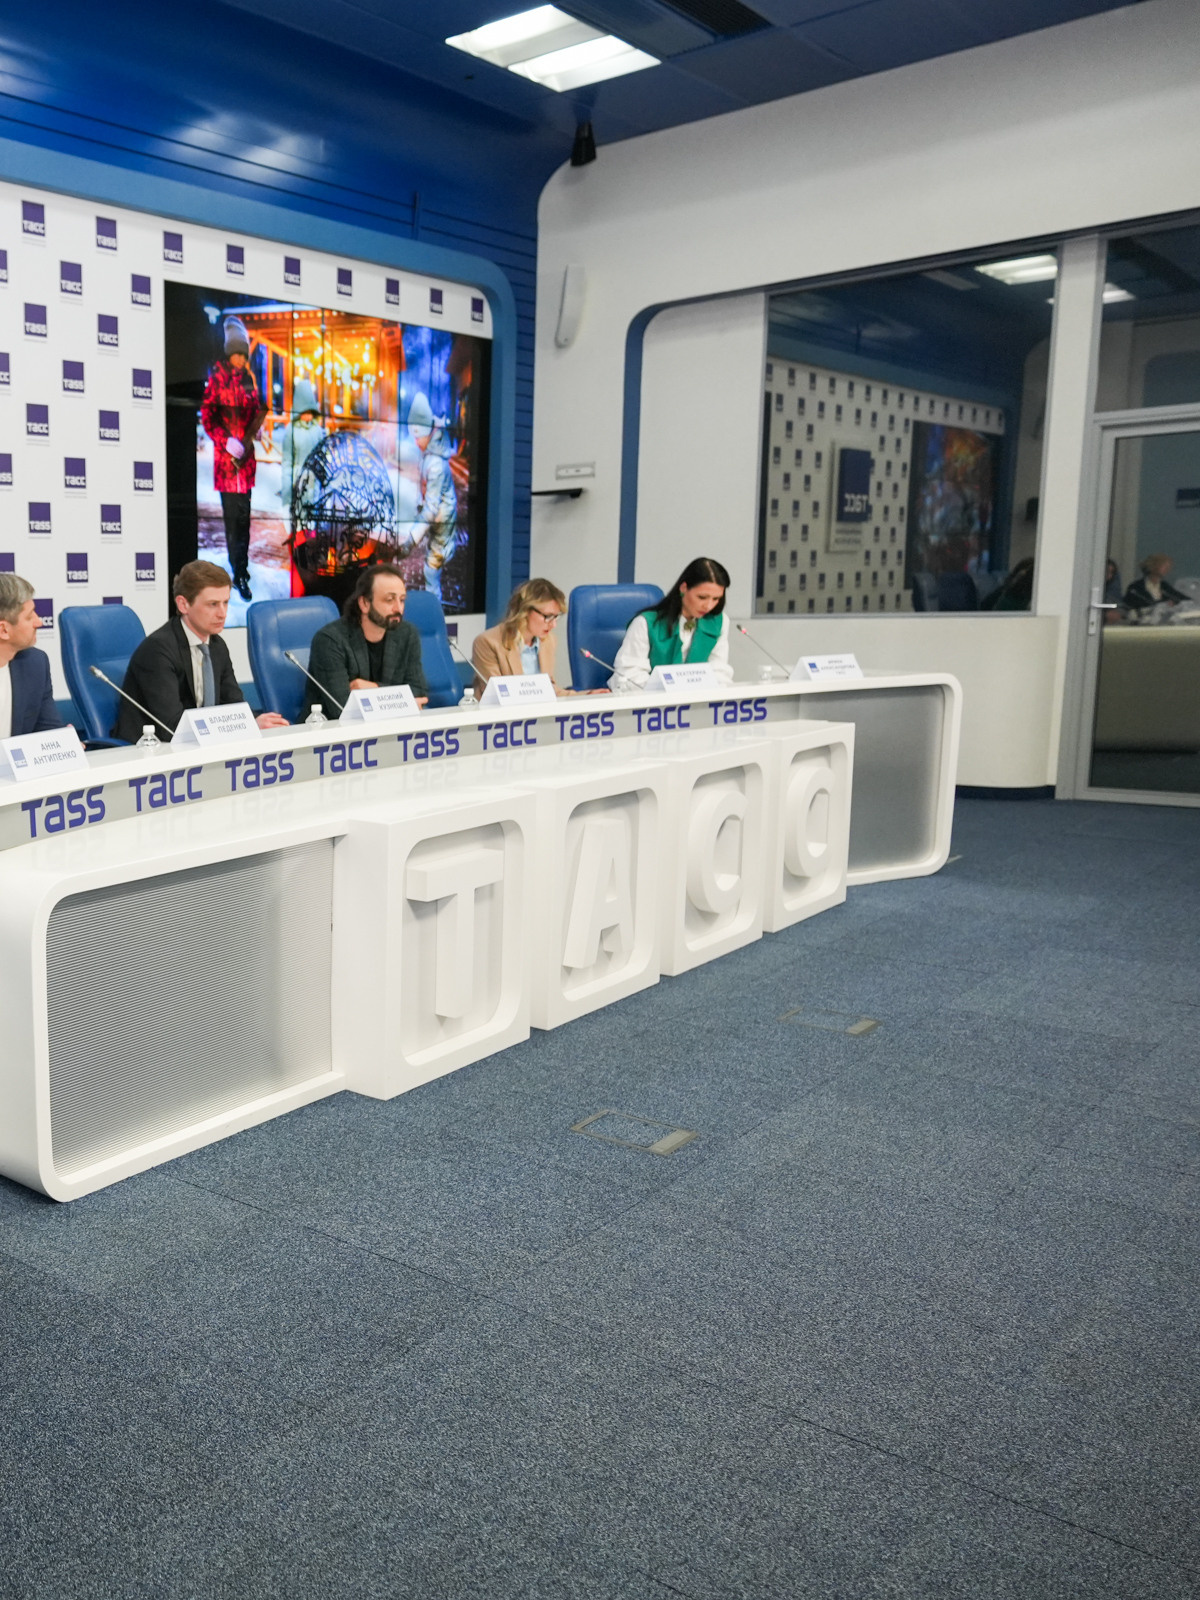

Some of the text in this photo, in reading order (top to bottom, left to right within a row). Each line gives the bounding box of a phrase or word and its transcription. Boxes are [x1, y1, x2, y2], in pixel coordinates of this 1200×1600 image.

[209, 713, 246, 724] ВЛАДИСЛАВ
[217, 723, 246, 732] ПЕДЕНКО
[41, 741, 61, 751] АННА
[34, 751, 76, 765] АНТИПЕНКО
